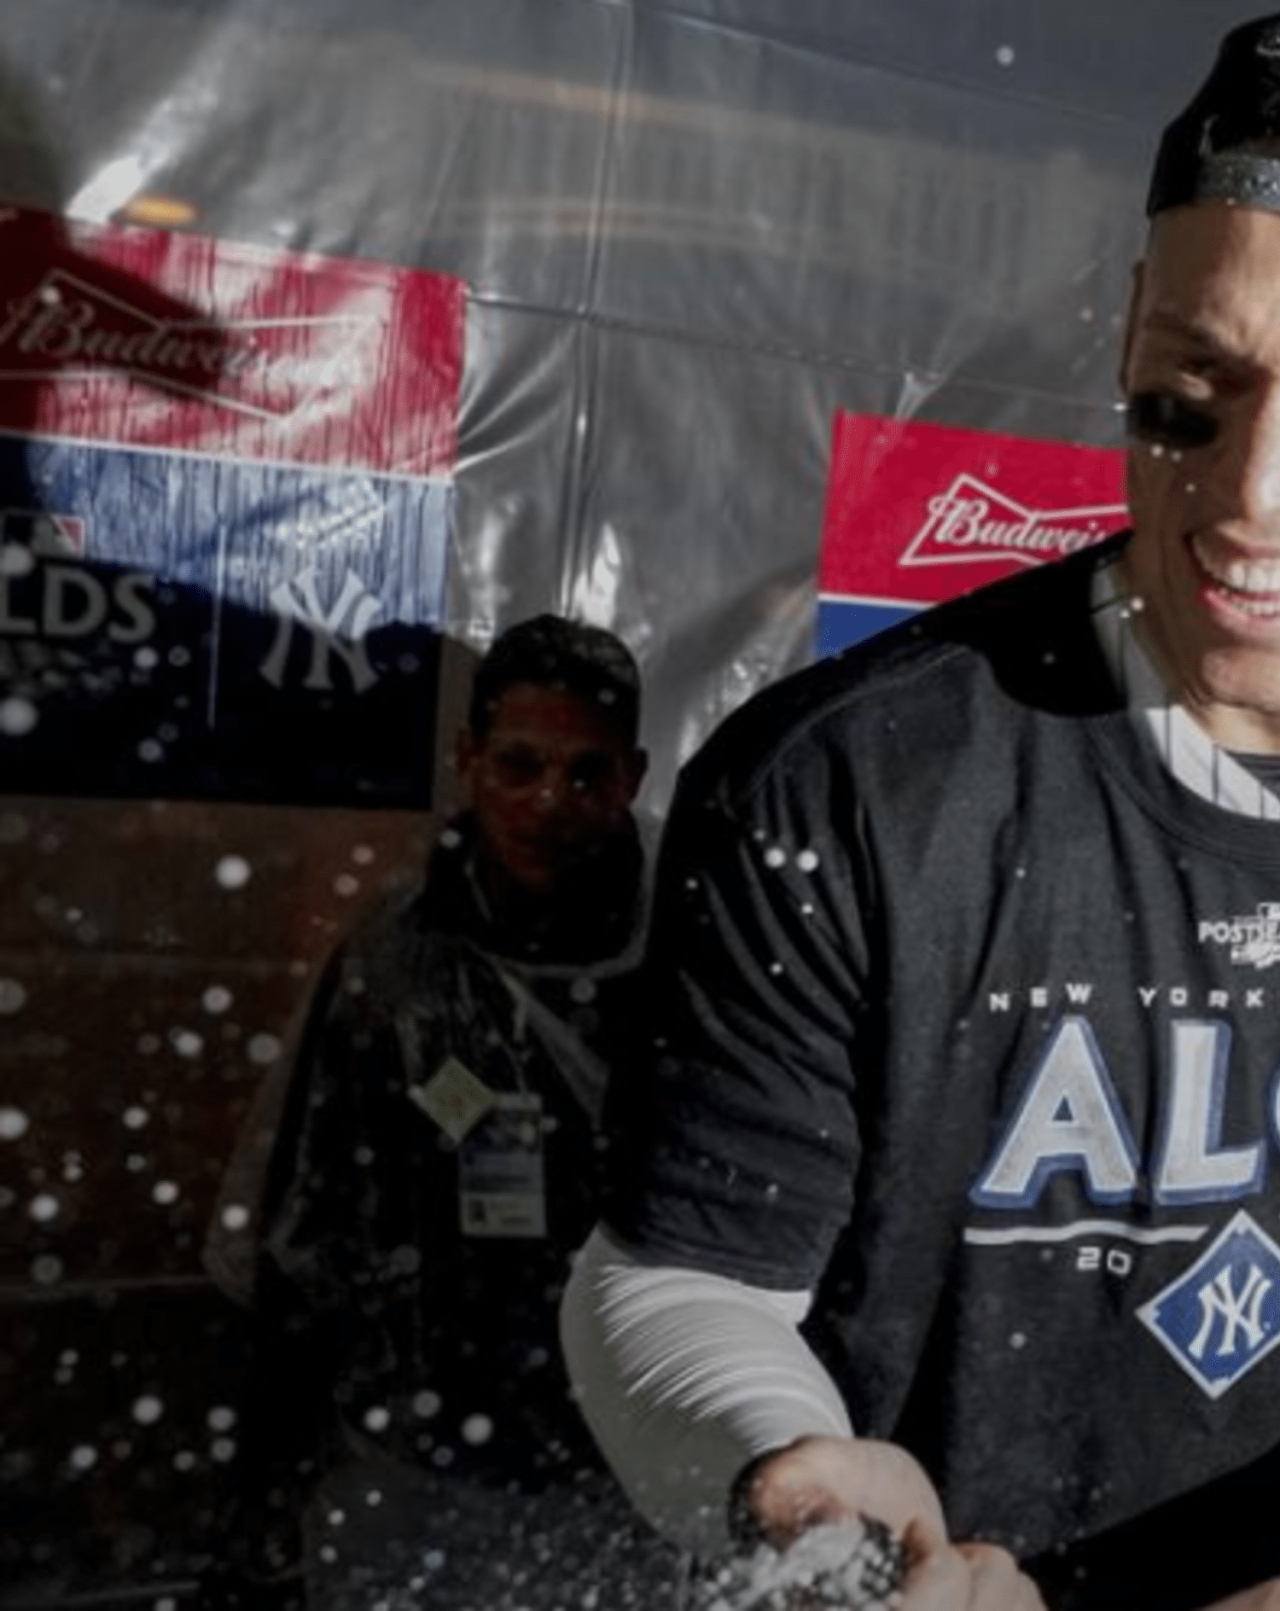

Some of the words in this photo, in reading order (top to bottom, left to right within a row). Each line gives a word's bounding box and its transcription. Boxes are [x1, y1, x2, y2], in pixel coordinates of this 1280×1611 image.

[928, 497, 1106, 556] Budwei
[989, 982, 1093, 1011] NEW
[1139, 986, 1266, 1009] YORK
[1076, 1246, 1132, 1276] 20
